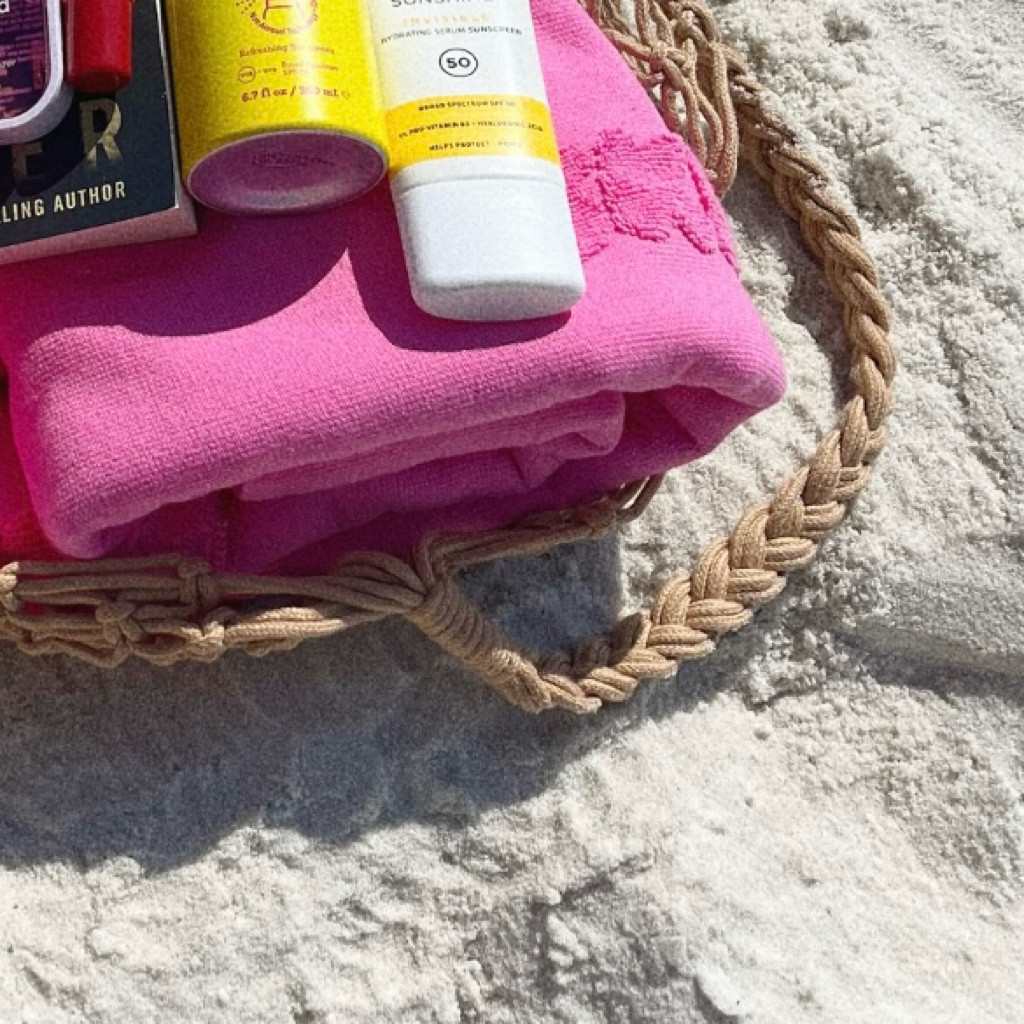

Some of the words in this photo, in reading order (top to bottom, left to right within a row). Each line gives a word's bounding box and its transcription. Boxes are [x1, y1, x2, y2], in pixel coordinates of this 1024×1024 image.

[380, 29, 433, 45] HYDRATING
[434, 27, 467, 35] SERUM
[468, 25, 523, 36] SUNSCREEN
[445, 57, 471, 69] 50
[53, 180, 126, 214] AUTHOR
